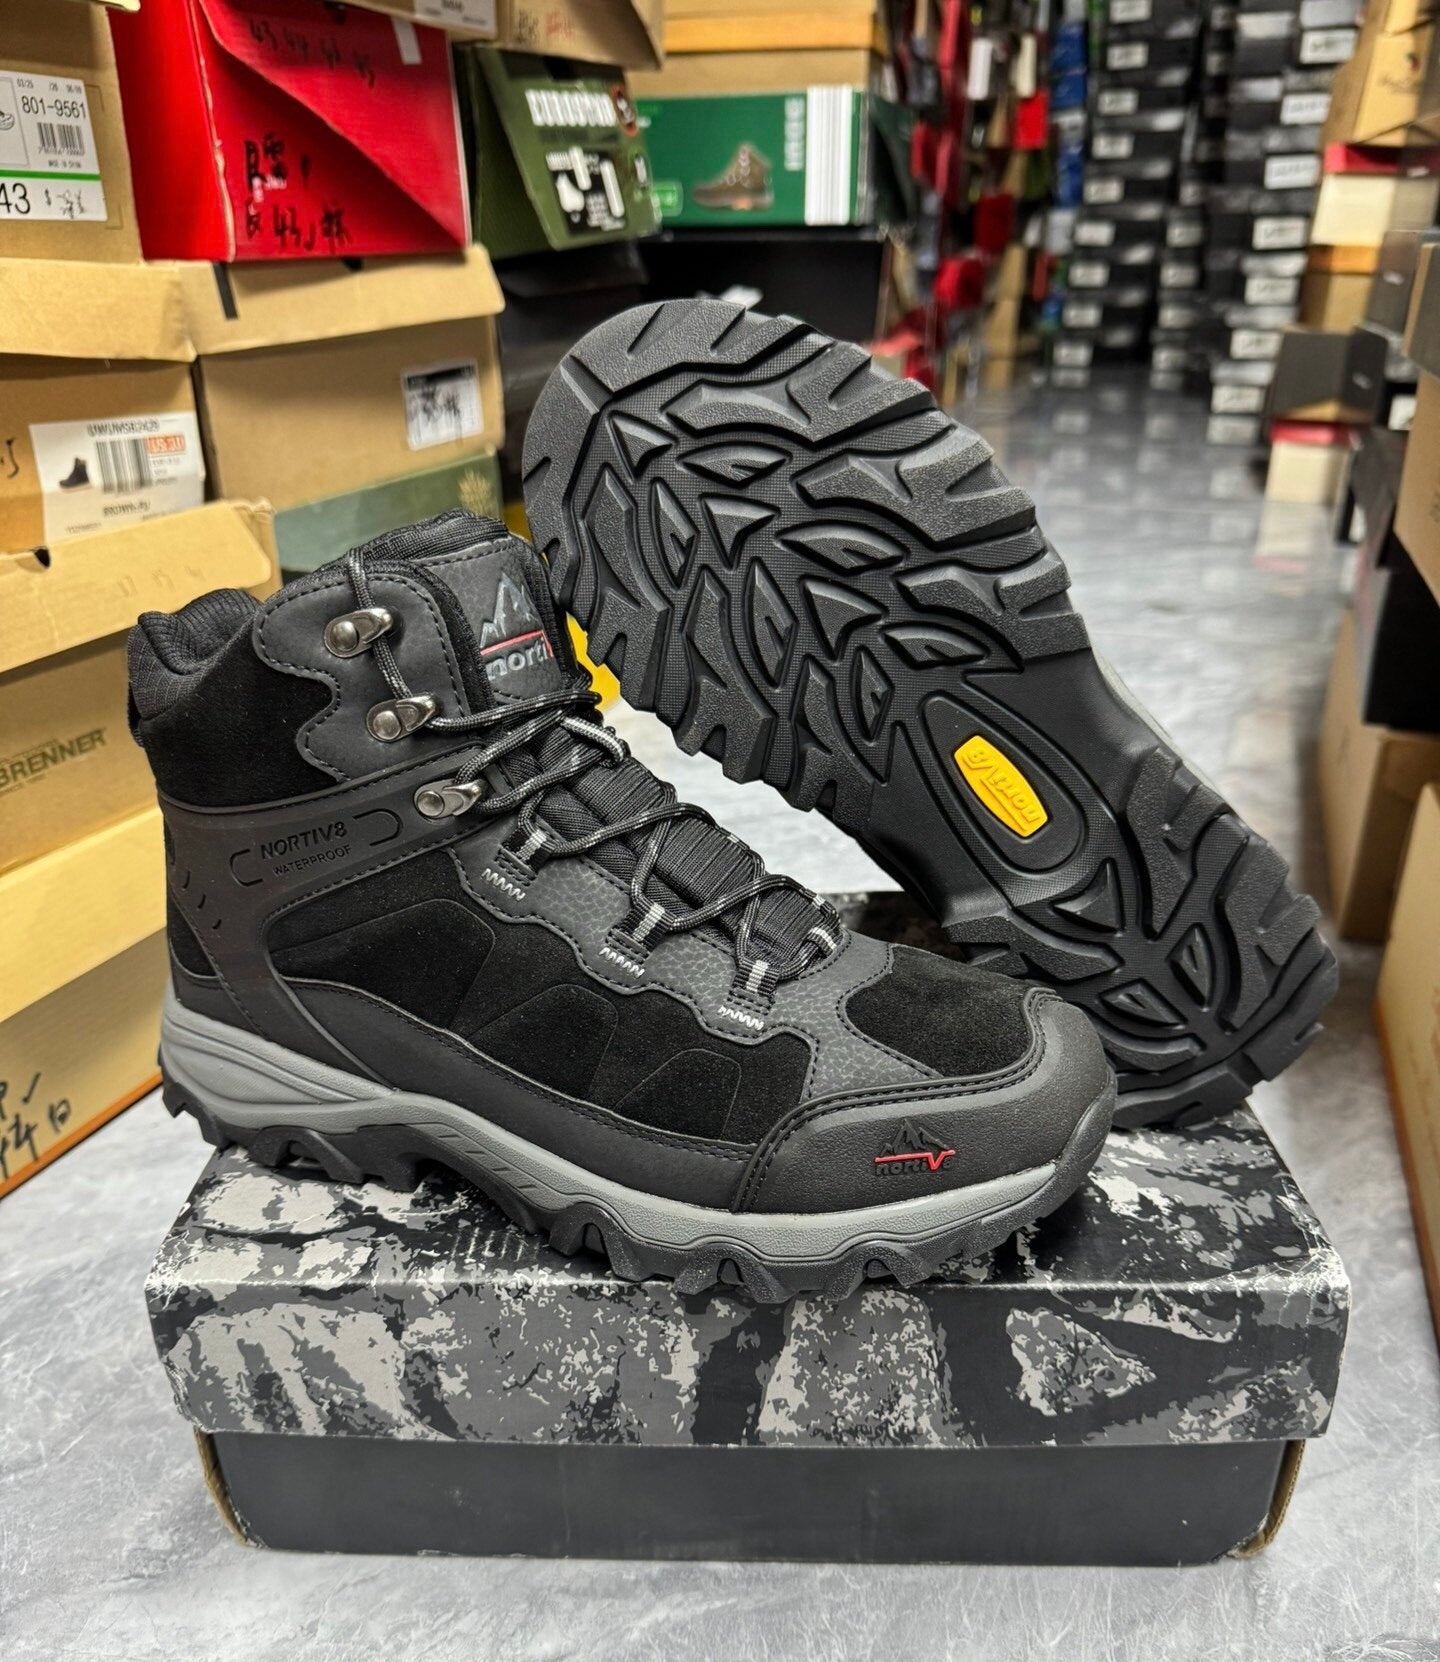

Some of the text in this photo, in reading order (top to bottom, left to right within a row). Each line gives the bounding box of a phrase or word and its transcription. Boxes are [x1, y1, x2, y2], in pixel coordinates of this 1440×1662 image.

[22, 95, 87, 119] 801-9561
[0, 183, 31, 215] 43
[0, 727, 107, 788] BRENNER
[259, 821, 348, 859] NORTIV8
[273, 844, 352, 876] WATERPROOF
